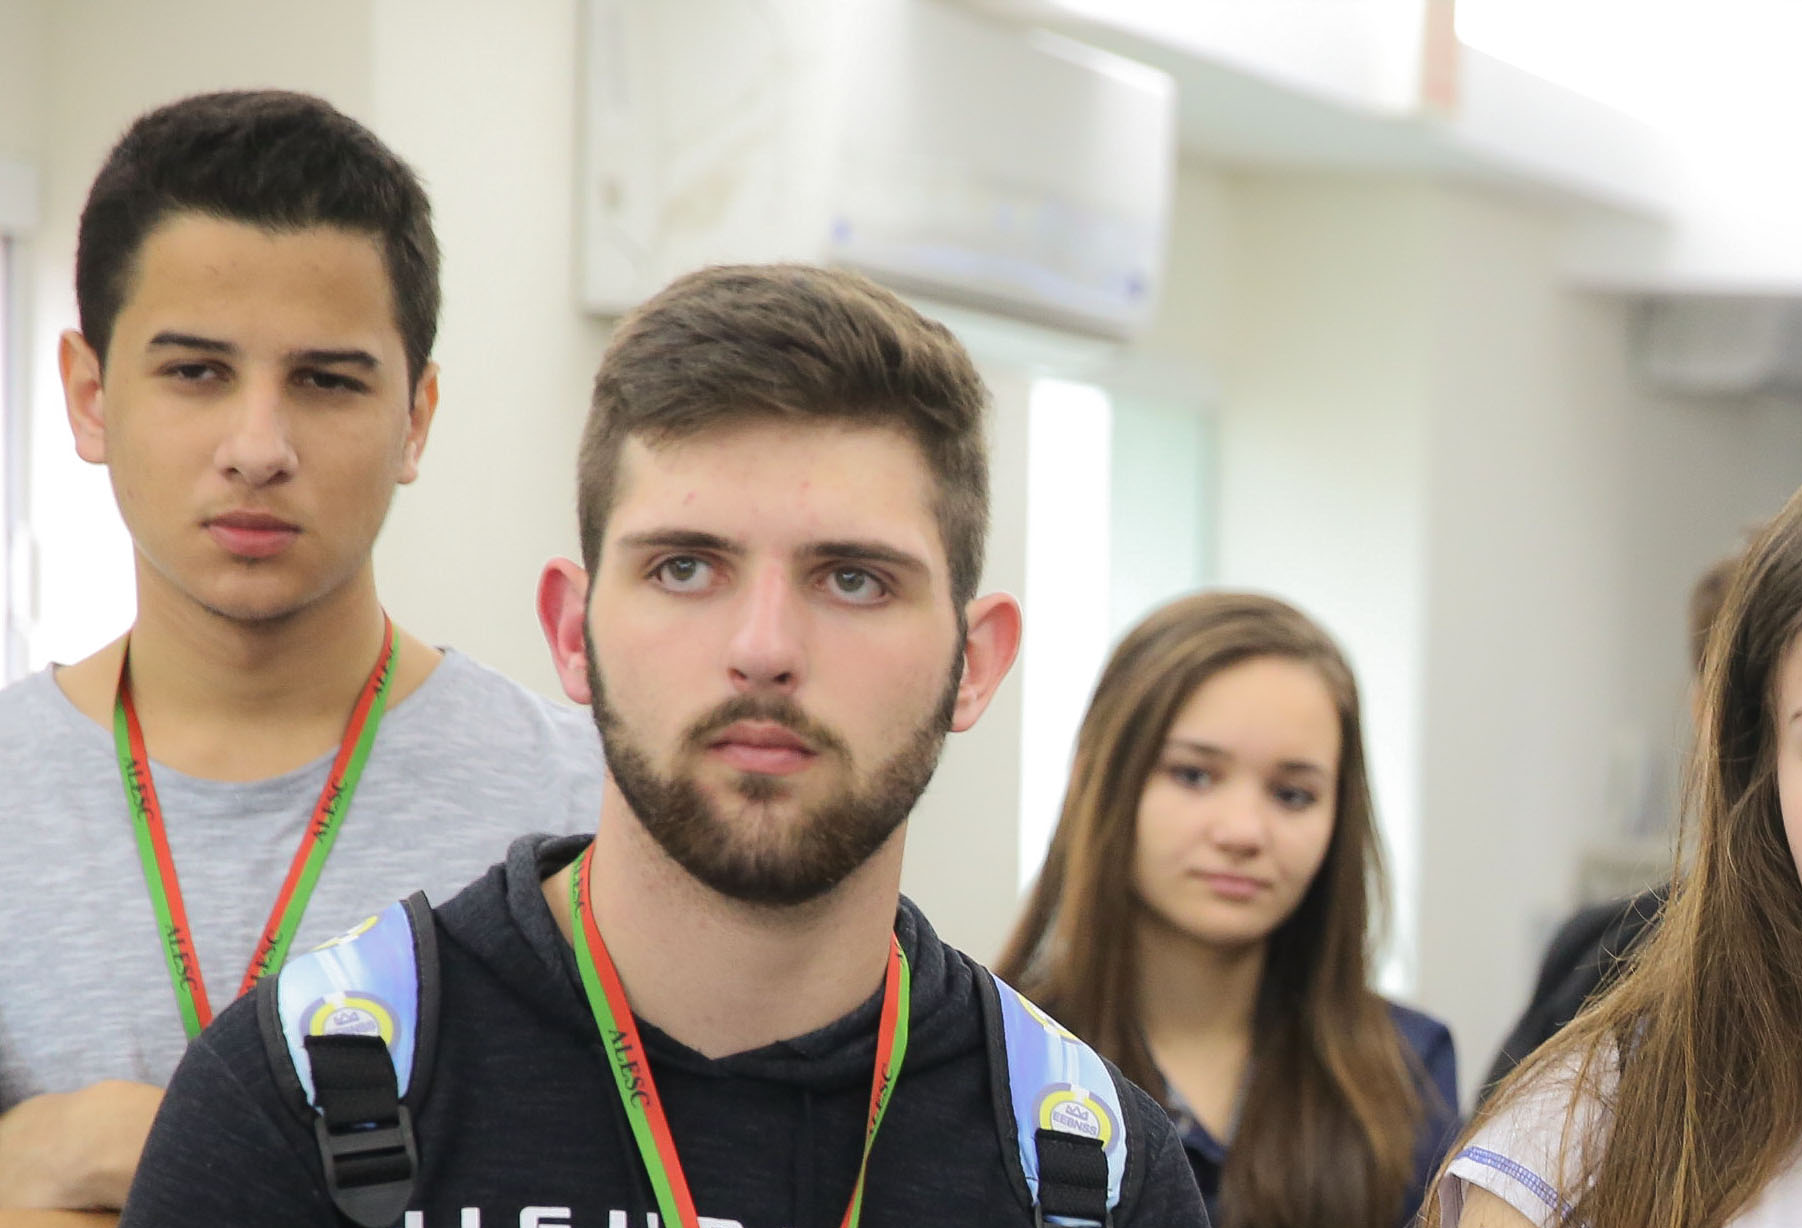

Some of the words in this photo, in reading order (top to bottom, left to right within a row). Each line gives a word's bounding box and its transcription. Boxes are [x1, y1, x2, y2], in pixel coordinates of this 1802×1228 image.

[124, 756, 154, 822] ALESC
[312, 776, 348, 844] ALESC
[165, 922, 198, 993] ALESC
[608, 1028, 650, 1109] ALESC
